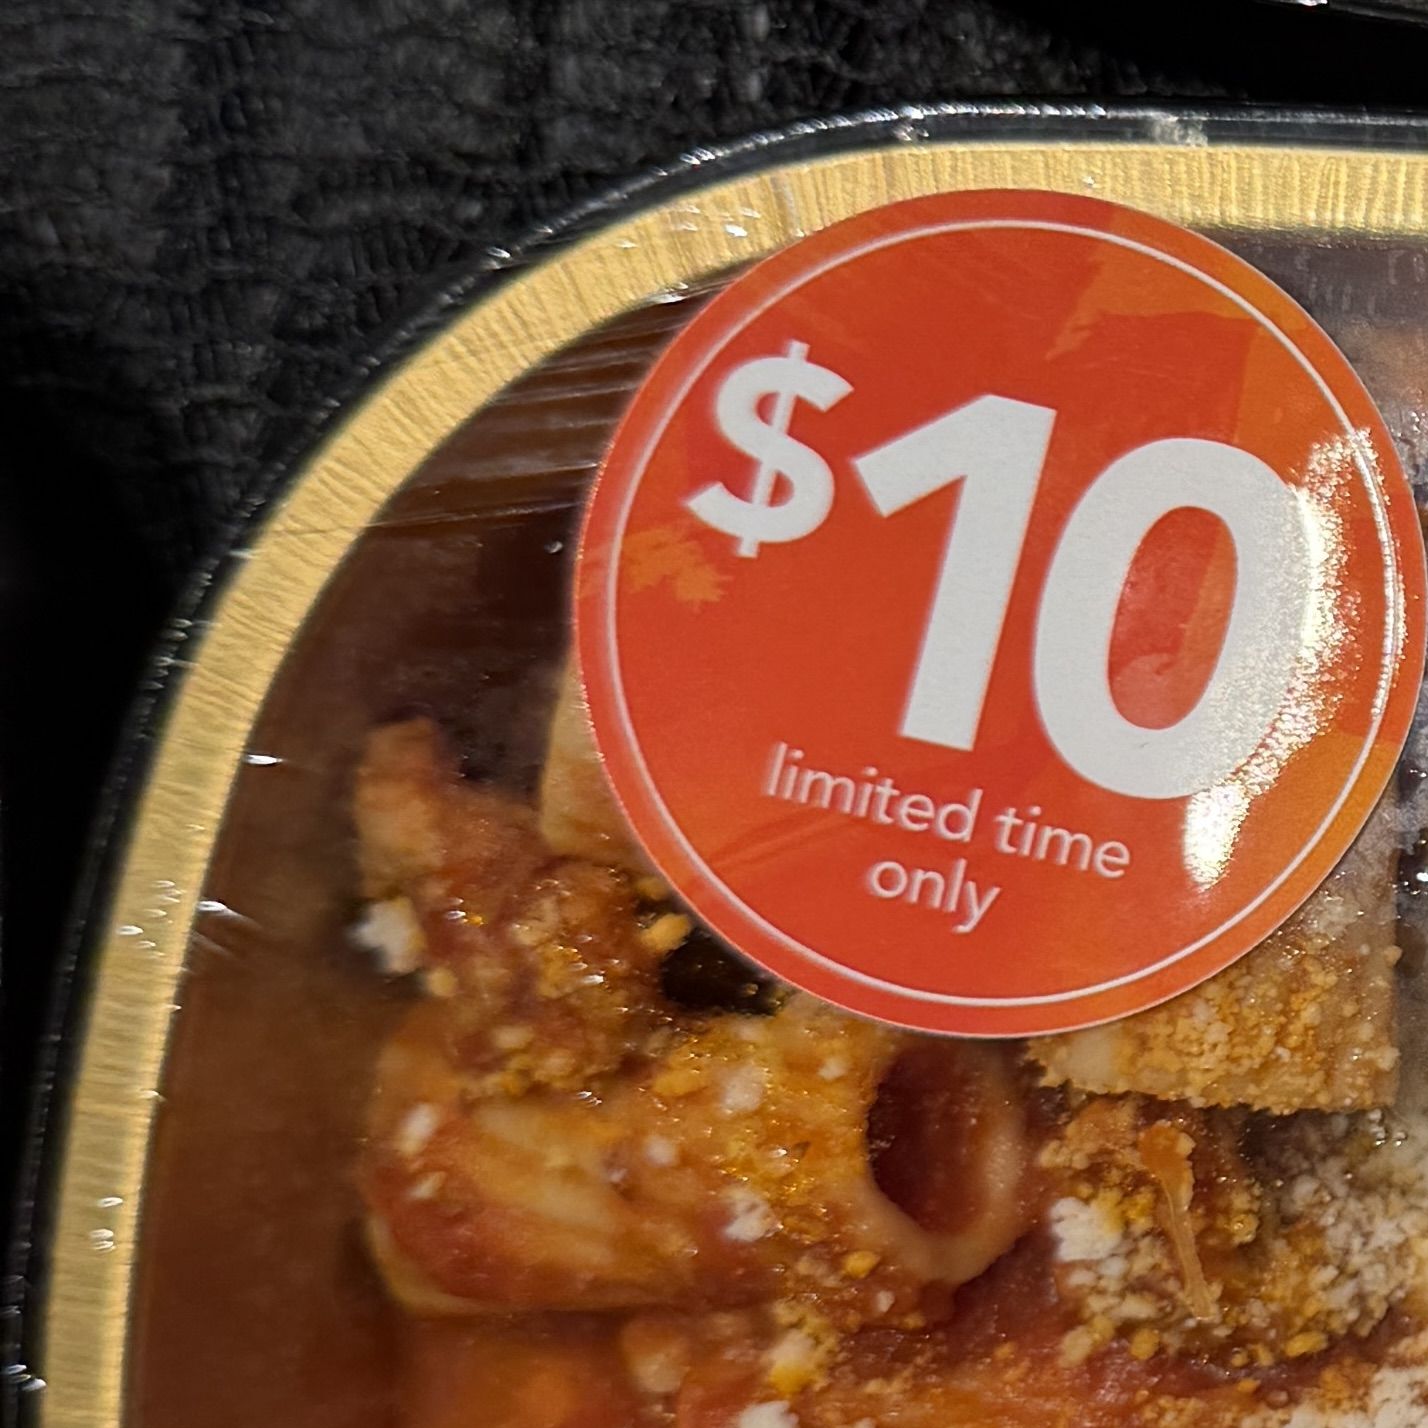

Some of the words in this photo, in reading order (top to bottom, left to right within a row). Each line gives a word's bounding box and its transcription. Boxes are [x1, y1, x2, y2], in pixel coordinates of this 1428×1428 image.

[682, 339, 1326, 802] $10
[762, 740, 981, 844] limited
[996, 804, 1131, 878] time
[866, 856, 1000, 934] only
